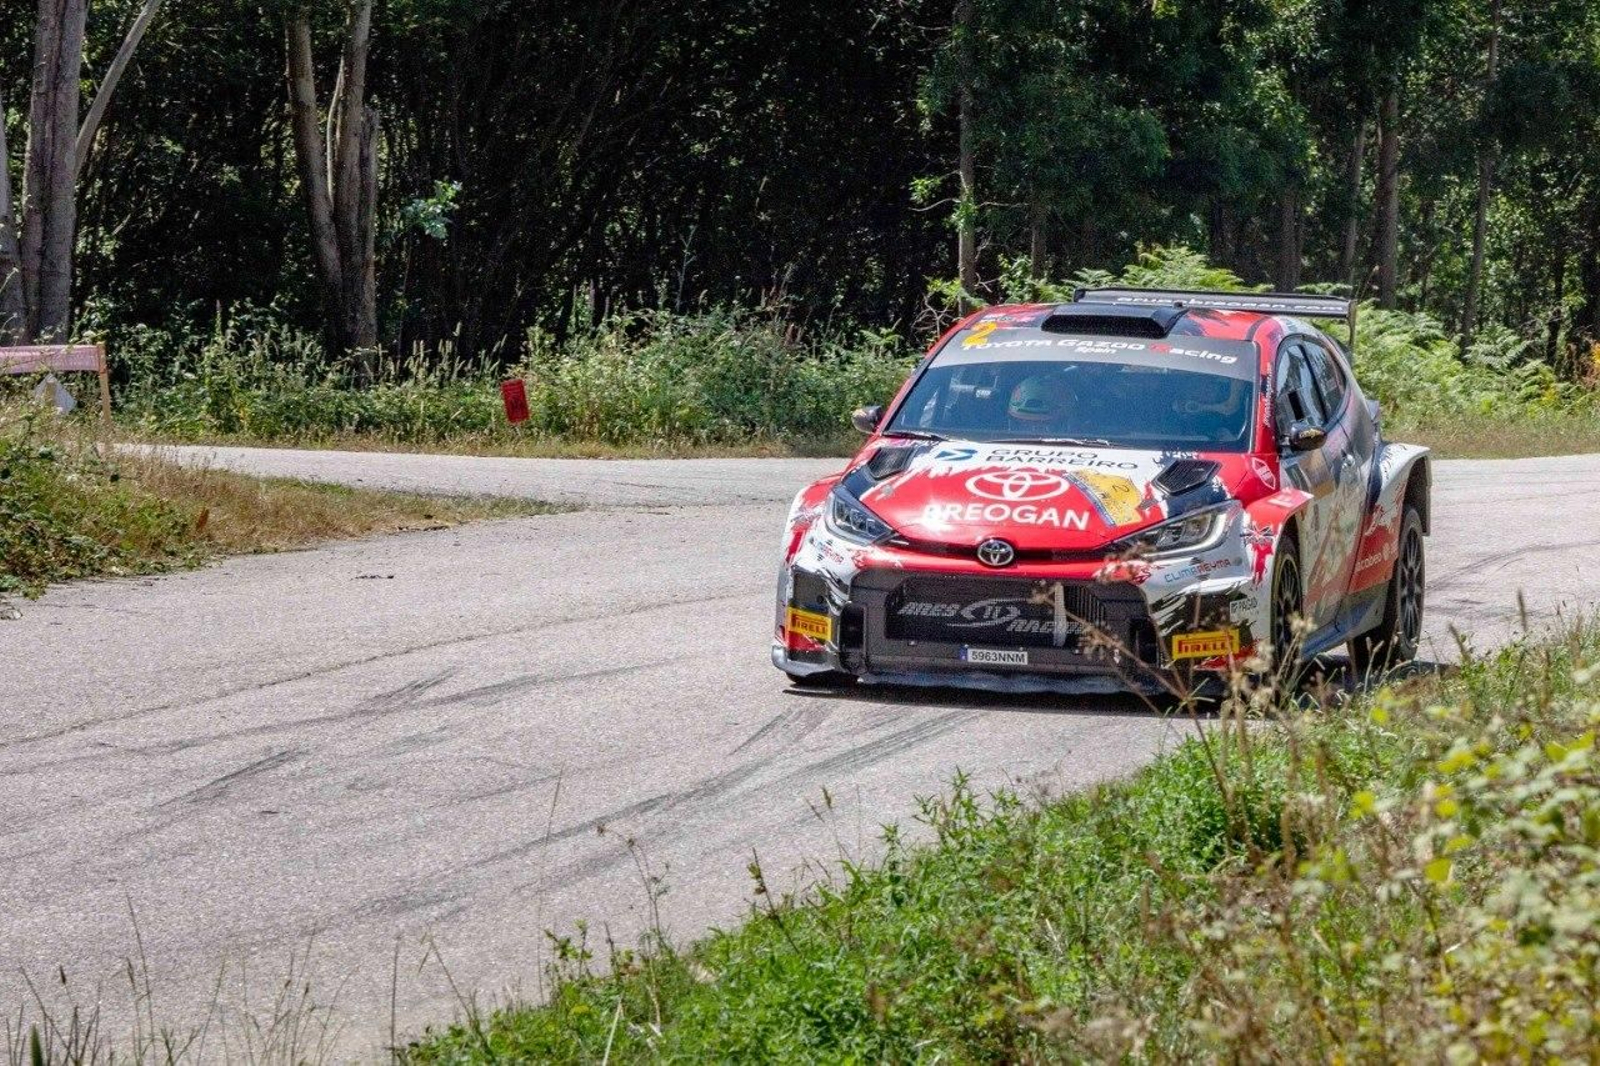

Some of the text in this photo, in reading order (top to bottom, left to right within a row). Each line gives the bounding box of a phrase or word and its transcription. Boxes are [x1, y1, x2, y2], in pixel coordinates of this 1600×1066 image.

[962, 320, 997, 346] 2
[962, 339, 1239, 364] TOYOTA GAZOO Racing
[985, 455, 1138, 470] BARREIRO
[991, 449, 1098, 460] GRUPO
[921, 502, 1090, 531] BREOGAN
[971, 650, 1026, 663] 5963NNM
